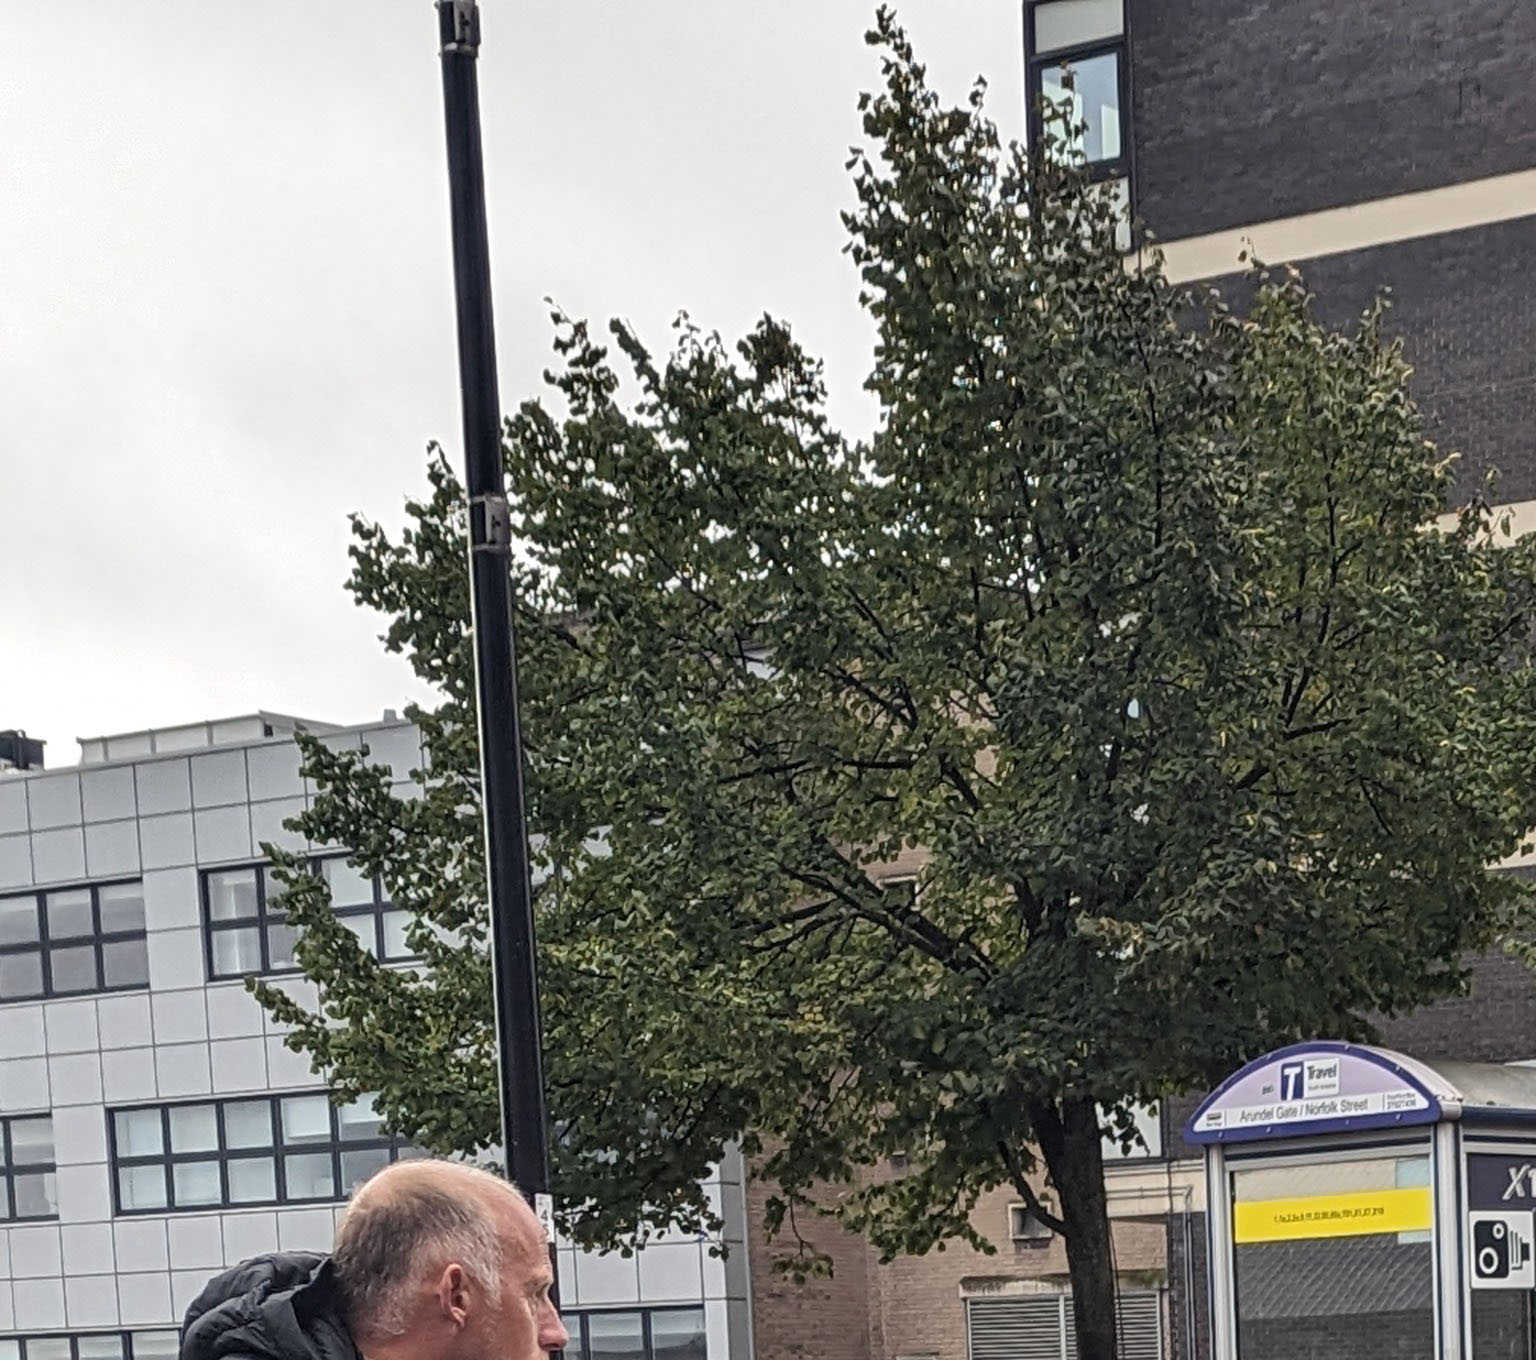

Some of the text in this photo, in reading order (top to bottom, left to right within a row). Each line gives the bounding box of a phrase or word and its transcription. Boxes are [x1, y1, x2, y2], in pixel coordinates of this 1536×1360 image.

[1307, 1063, 1337, 1079] Travel
[1240, 1107, 1275, 1123] Arundel
[1276, 1105, 1299, 1120] Gate
[1305, 1101, 1339, 1115] Norfolk
[1340, 1097, 1368, 1113] Street
